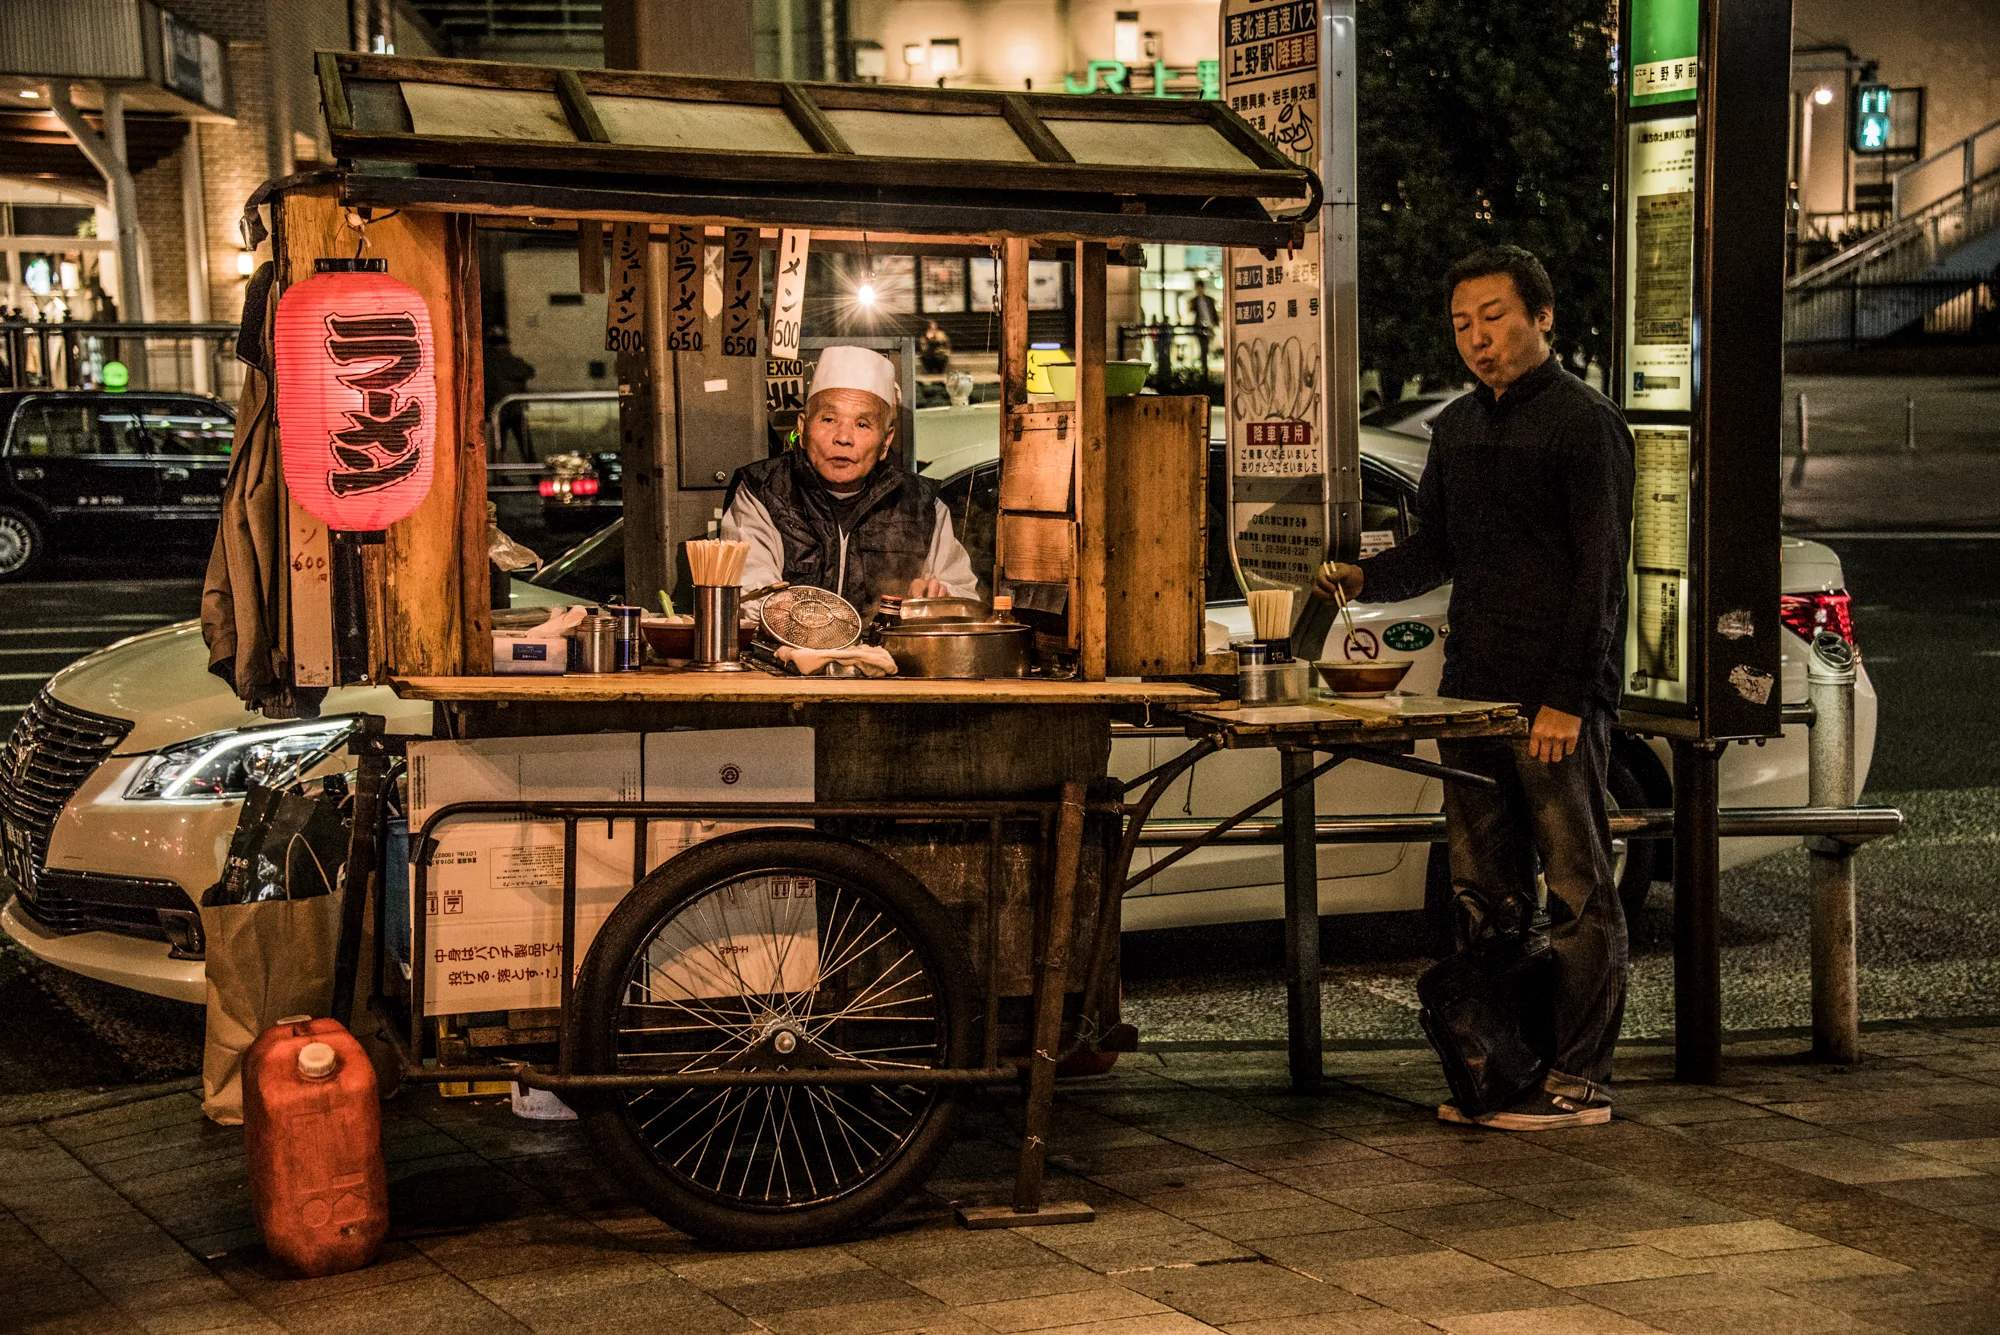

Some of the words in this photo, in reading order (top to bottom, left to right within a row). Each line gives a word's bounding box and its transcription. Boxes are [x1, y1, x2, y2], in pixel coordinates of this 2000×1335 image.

[1231, 3, 1316, 43] 東北道高速バス
[1230, 42, 1274, 77] 上野駅
[1277, 35, 1316, 68] 降車場
[608, 326, 642, 351] 800
[668, 331, 703, 351] 650
[773, 318, 800, 349] 600
[724, 335, 757, 356] 650
[766, 360, 803, 376] EXKO
[325, 312, 424, 498] ラーメン
[1253, 424, 1304, 443] 降車専用
[1241, 461, 1317, 473] ありがとうございました
